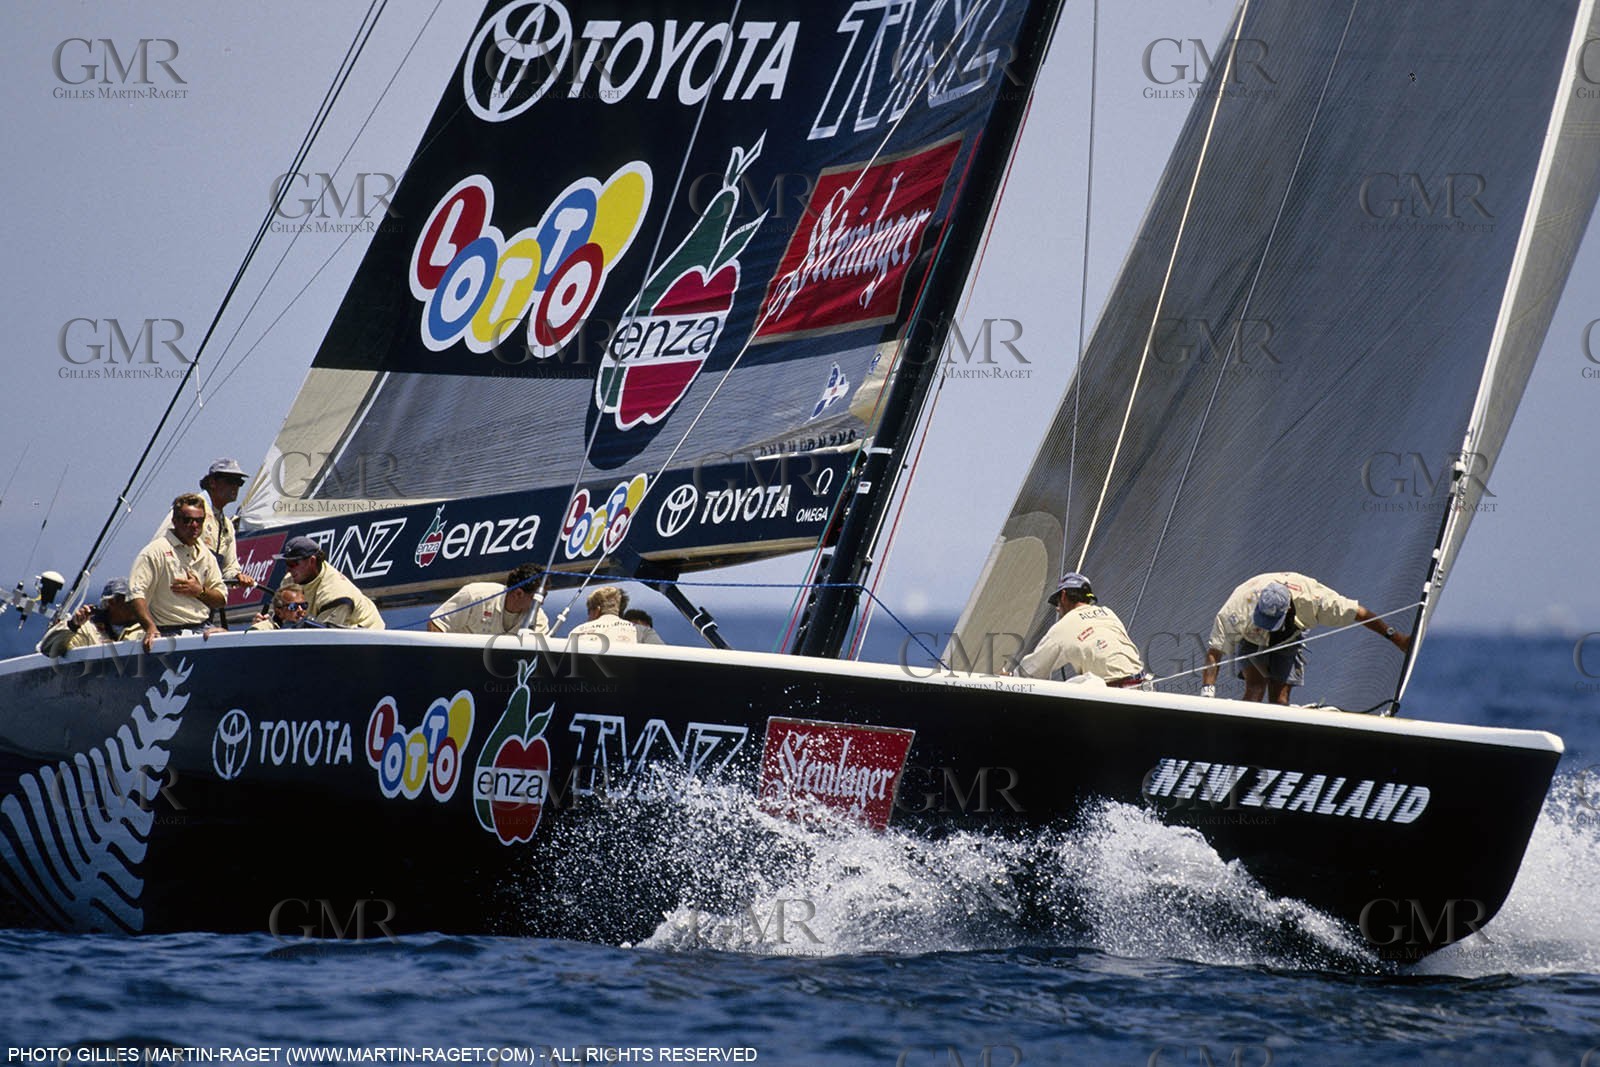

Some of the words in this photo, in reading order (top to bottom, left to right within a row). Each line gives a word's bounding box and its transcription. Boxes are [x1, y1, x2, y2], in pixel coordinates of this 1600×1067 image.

[567, 19, 801, 106] TOYOTA
[413, 180, 604, 348] LOTTO
[609, 315, 720, 363] enza
[700, 484, 792, 525] TOYOTA
[795, 507, 829, 523] OMEGA
[442, 514, 541, 560] enza
[259, 719, 353, 767] TOYOTA
[367, 702, 460, 795] LOTTO
[477, 770, 543, 799] enza
[761, 729, 895, 811] Steinlager
[1149, 757, 1248, 802] NEW
[1240, 768, 1431, 824] ZEALAND
